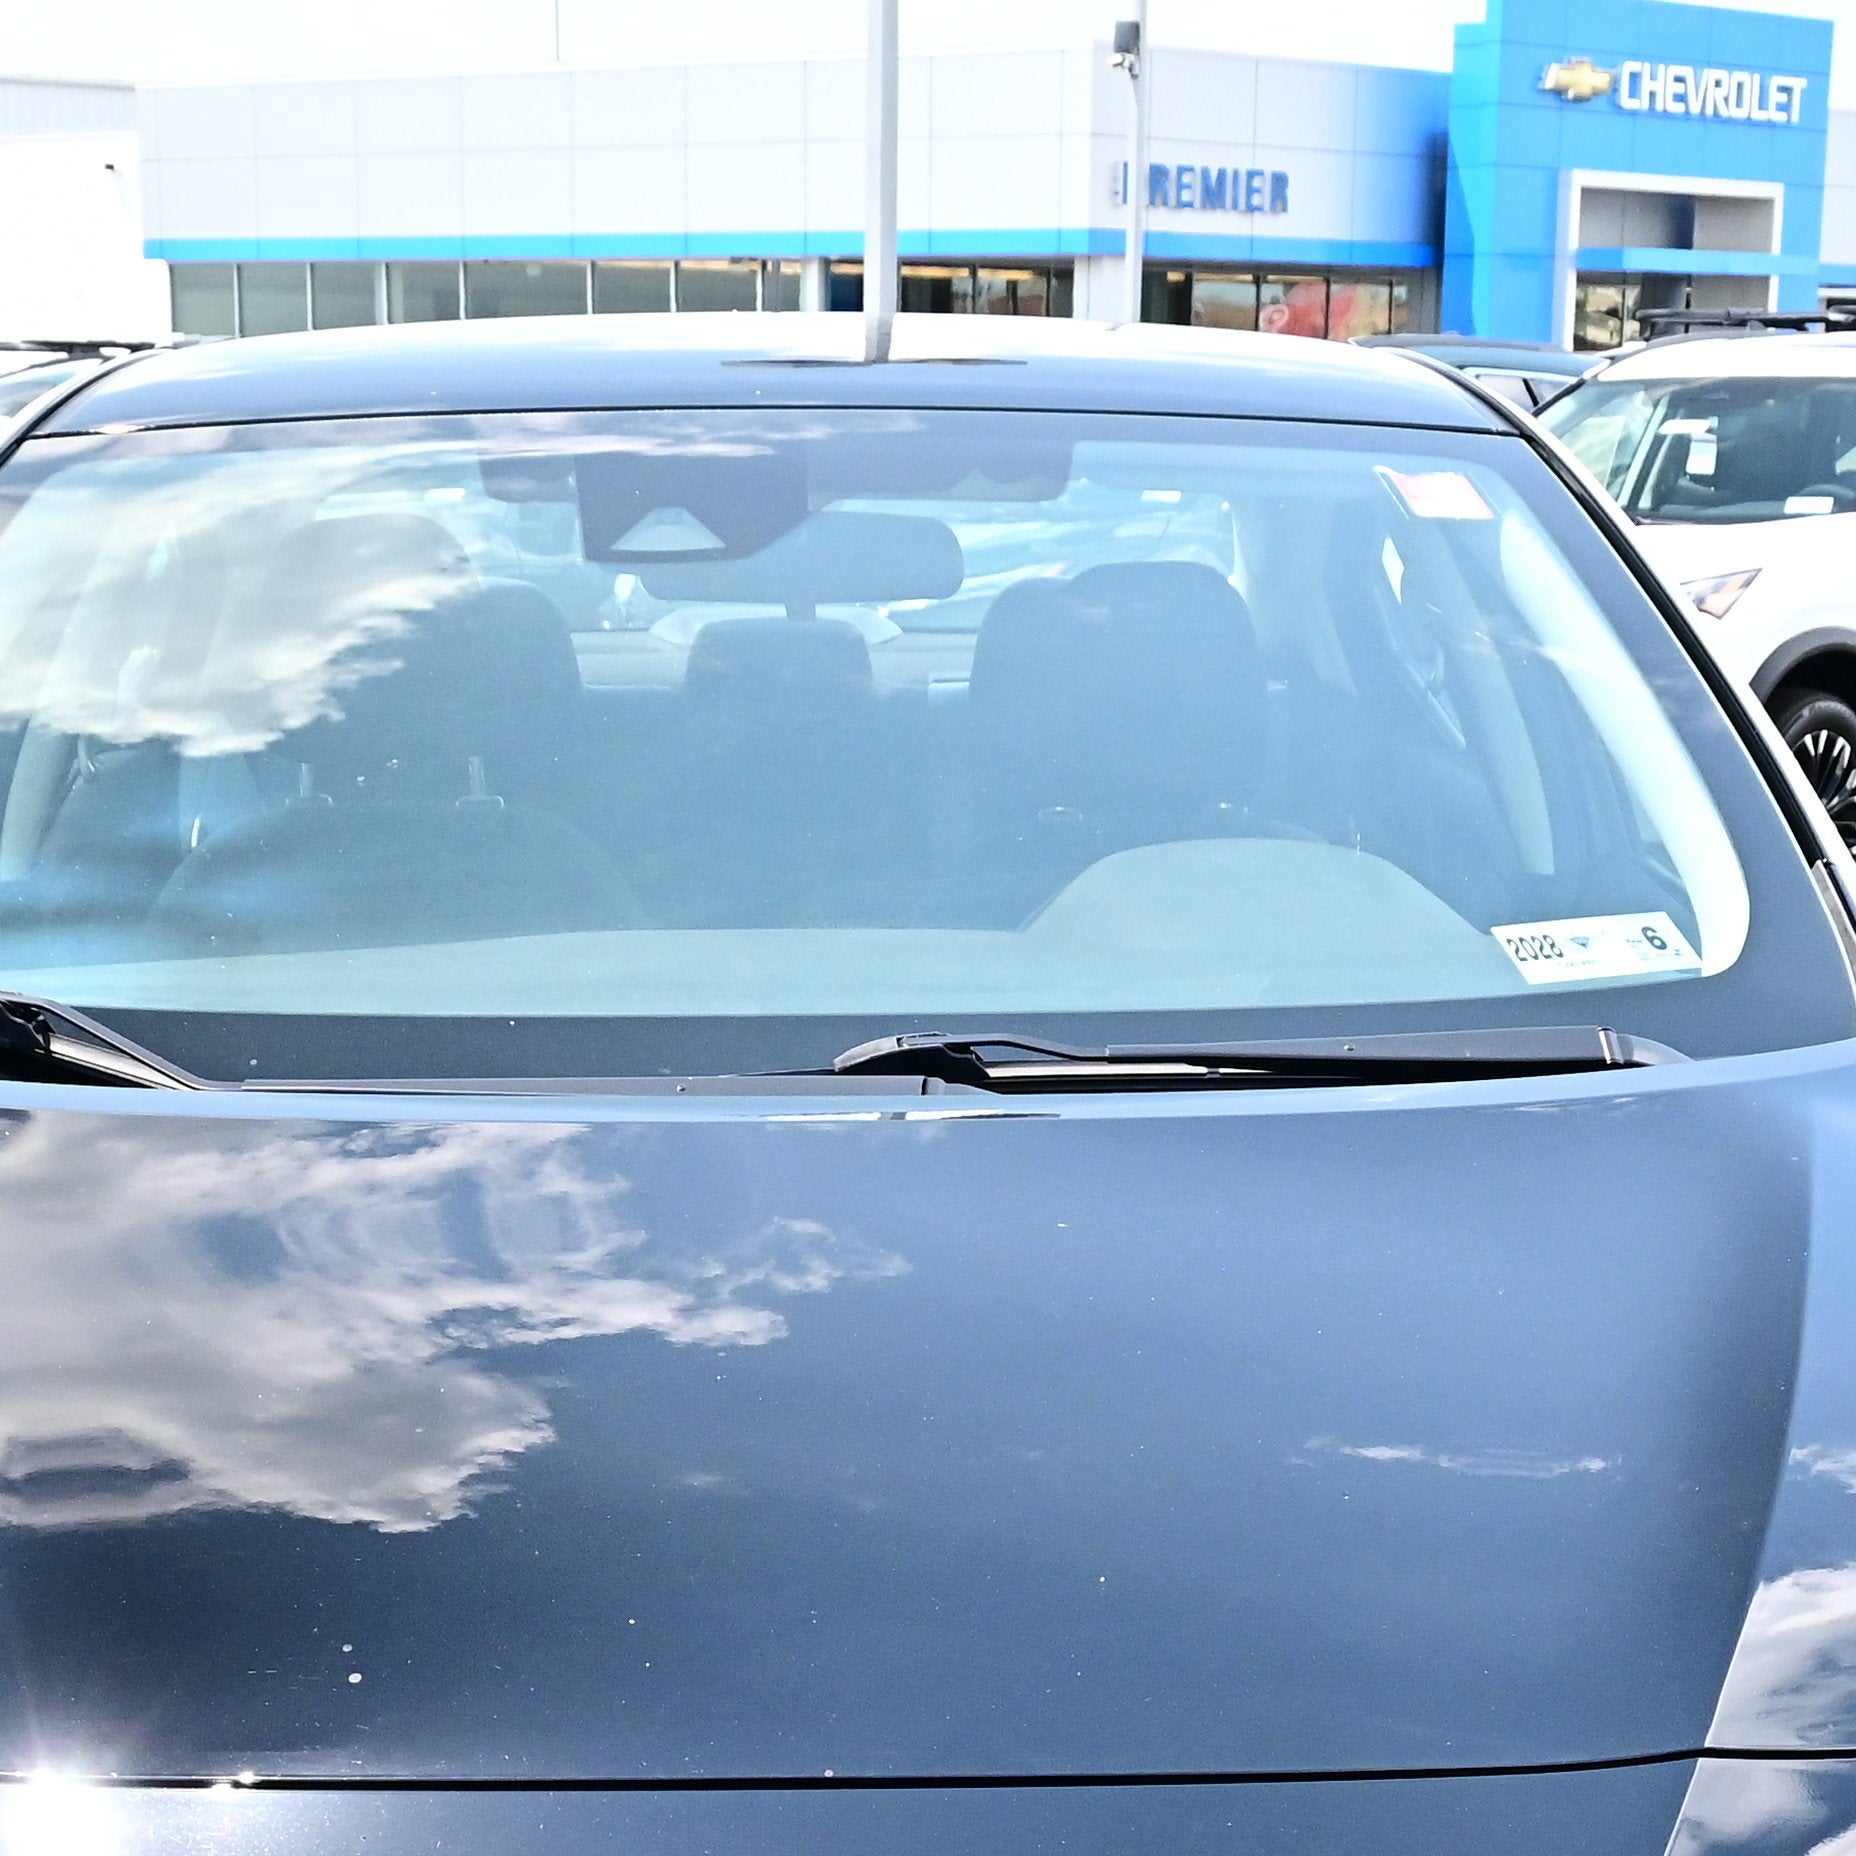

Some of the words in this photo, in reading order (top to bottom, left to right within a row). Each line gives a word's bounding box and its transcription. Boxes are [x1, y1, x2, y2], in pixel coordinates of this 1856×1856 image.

[1620, 60, 1808, 123] CHEVROLET
[1121, 161, 1289, 213] REMIER
[1506, 934, 1564, 962] 2028
[1641, 926, 1668, 950] 6
